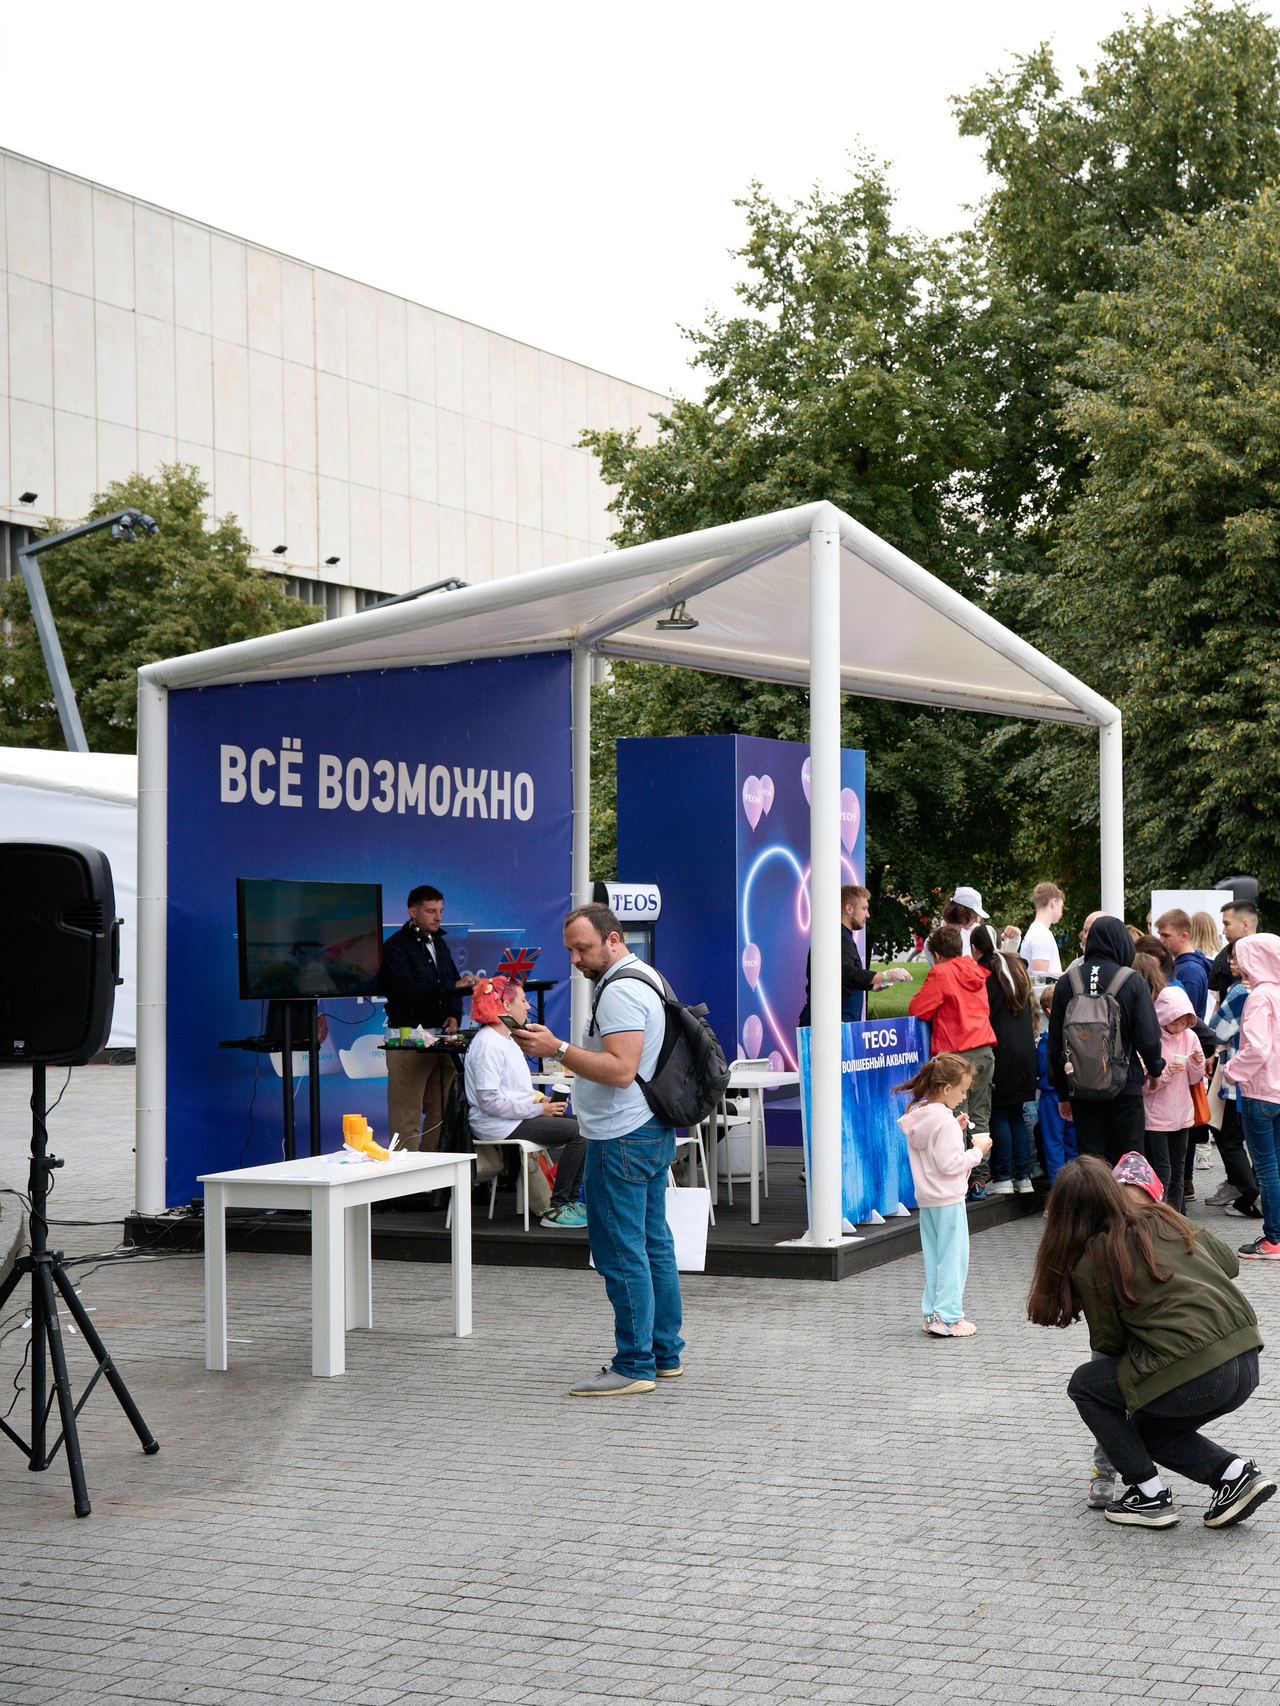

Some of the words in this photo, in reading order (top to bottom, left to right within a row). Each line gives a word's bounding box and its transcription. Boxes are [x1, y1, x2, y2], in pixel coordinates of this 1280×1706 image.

[220, 737, 303, 808] ВСЁ
[318, 754, 534, 821] ВОЗМОЖНО
[745, 793, 761, 804] TEOS
[612, 893, 658, 912] TEOS
[862, 1029, 898, 1049] TEOS
[841, 1052, 885, 1073] ВОЛШЕБНЫЙ
[886, 1051, 919, 1067] АКВАГРИМ
